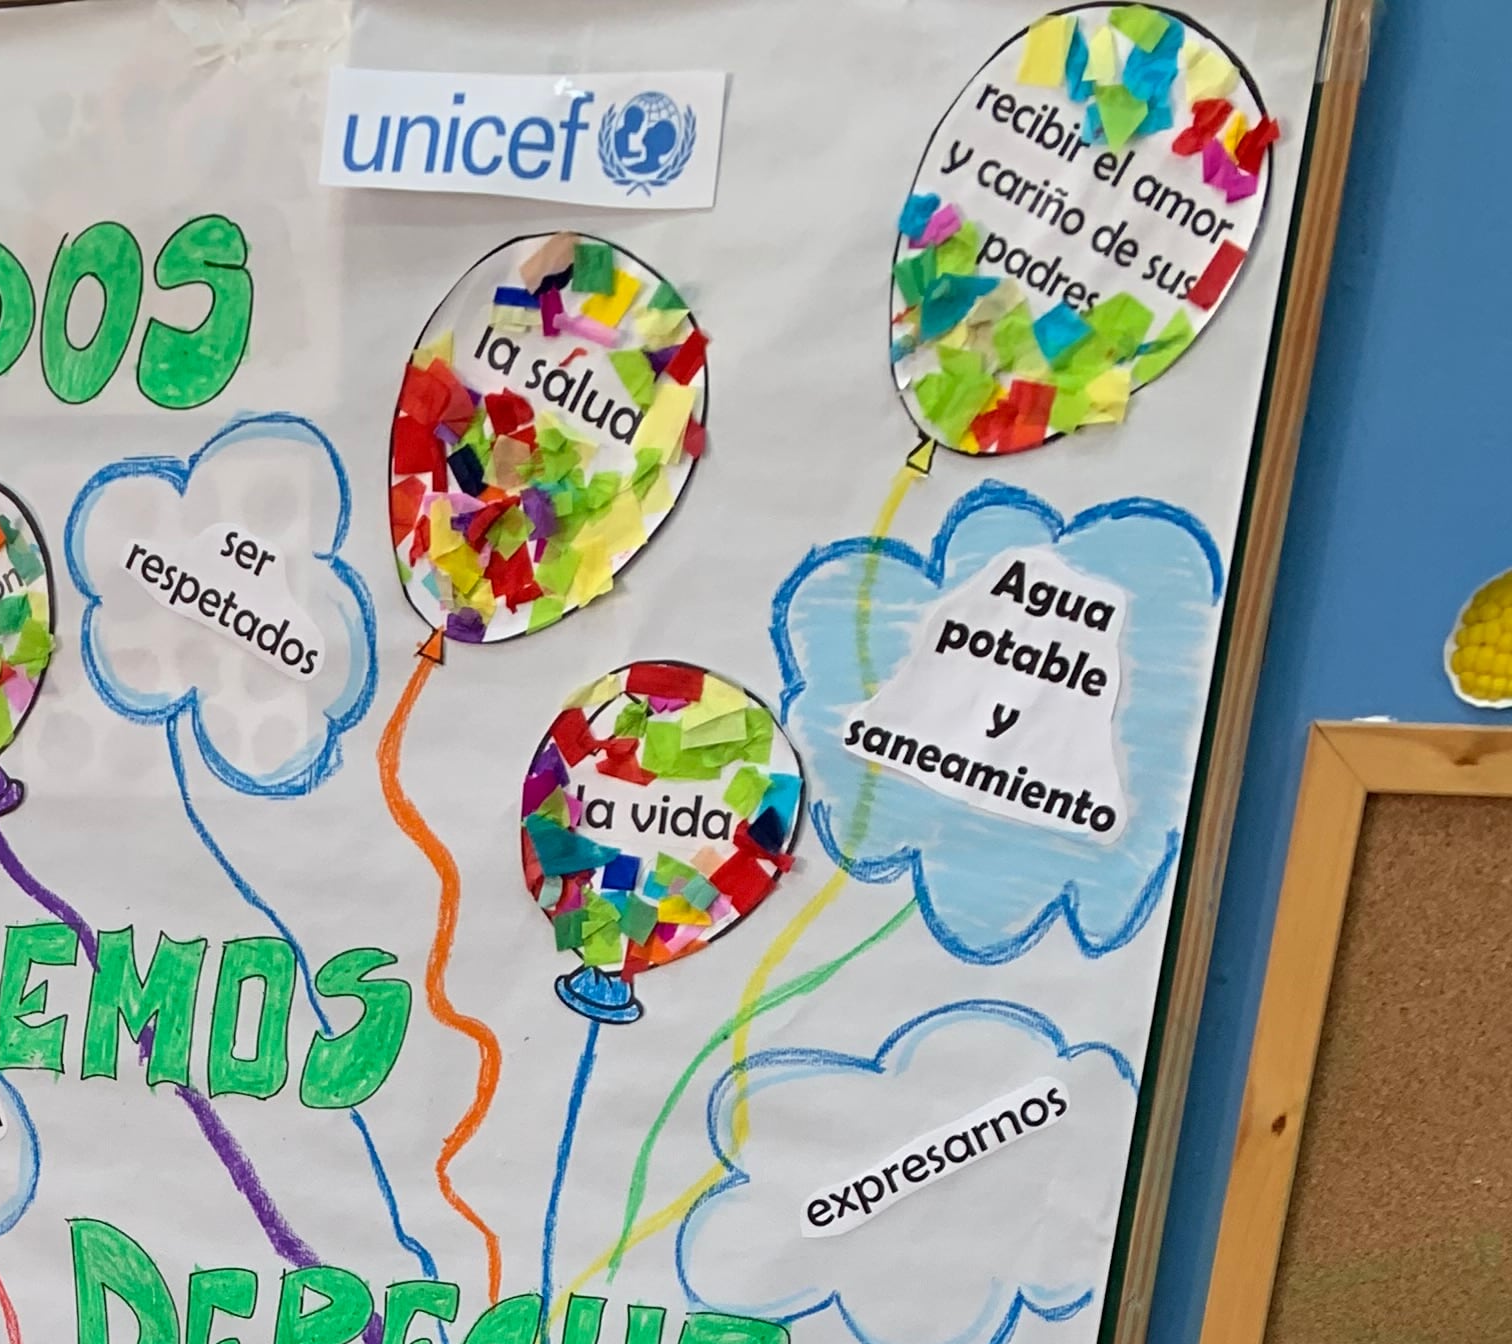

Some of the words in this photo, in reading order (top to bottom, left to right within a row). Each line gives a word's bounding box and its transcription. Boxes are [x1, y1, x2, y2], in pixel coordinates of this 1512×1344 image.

[342, 91, 595, 182] unicef
[975, 83, 1091, 163] recibir
[1093, 149, 1136, 187] el
[1133, 173, 1235, 244] amor
[940, 139, 975, 175] y
[976, 159, 1086, 236] cariño
[1091, 220, 1139, 267] de
[1141, 254, 1199, 301] sus
[474, 324, 521, 376] la
[220, 531, 276, 577] ser
[990, 559, 1116, 632] Agua
[124, 543, 319, 675] respetados
[935, 618, 1108, 697] potable
[985, 703, 1021, 738] y
[630, 794, 733, 841] vida
[844, 719, 1117, 833] saneamiento
[806, 1086, 1068, 1228] expresarnos
